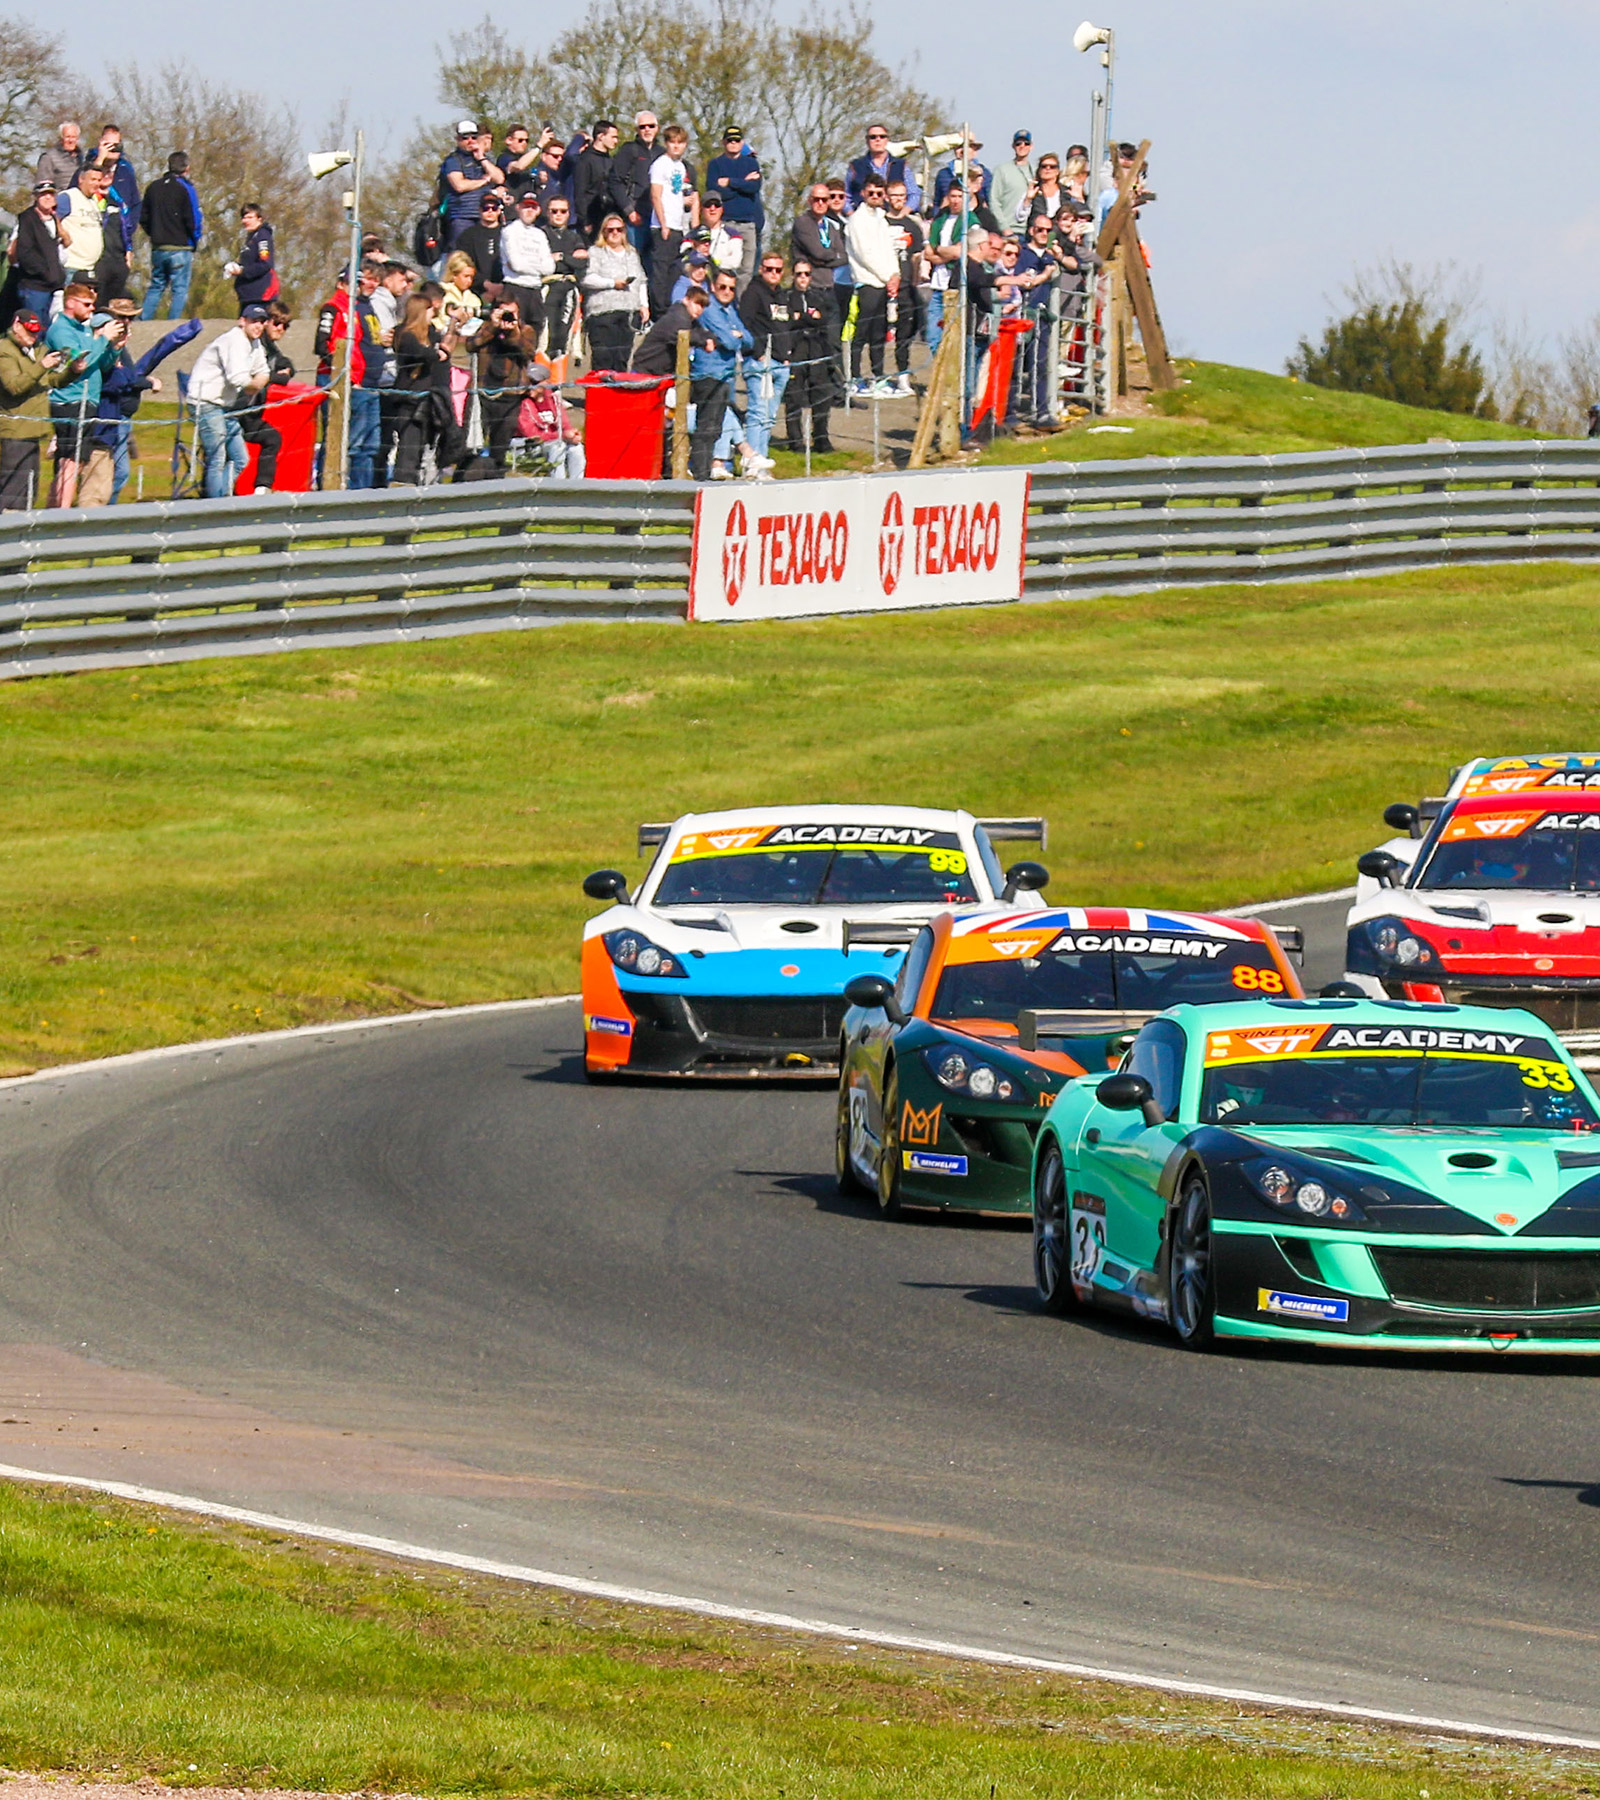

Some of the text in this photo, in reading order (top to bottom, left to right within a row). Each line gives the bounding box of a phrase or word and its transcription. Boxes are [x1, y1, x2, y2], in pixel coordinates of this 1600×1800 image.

[757, 509, 849, 586] TEXACO
[912, 501, 1001, 576] TEXACO
[707, 826, 935, 850] GT ACADEMY
[928, 851, 968, 875] 99
[992, 934, 1228, 959] GT ACADEMY
[1231, 964, 1285, 994] 88
[1235, 1027, 1317, 1039] GINETTA
[1246, 1028, 1525, 1054] GT ACADEMY
[1517, 1061, 1576, 1093] 33
[1282, 1300, 1337, 1314] MICHELIN
